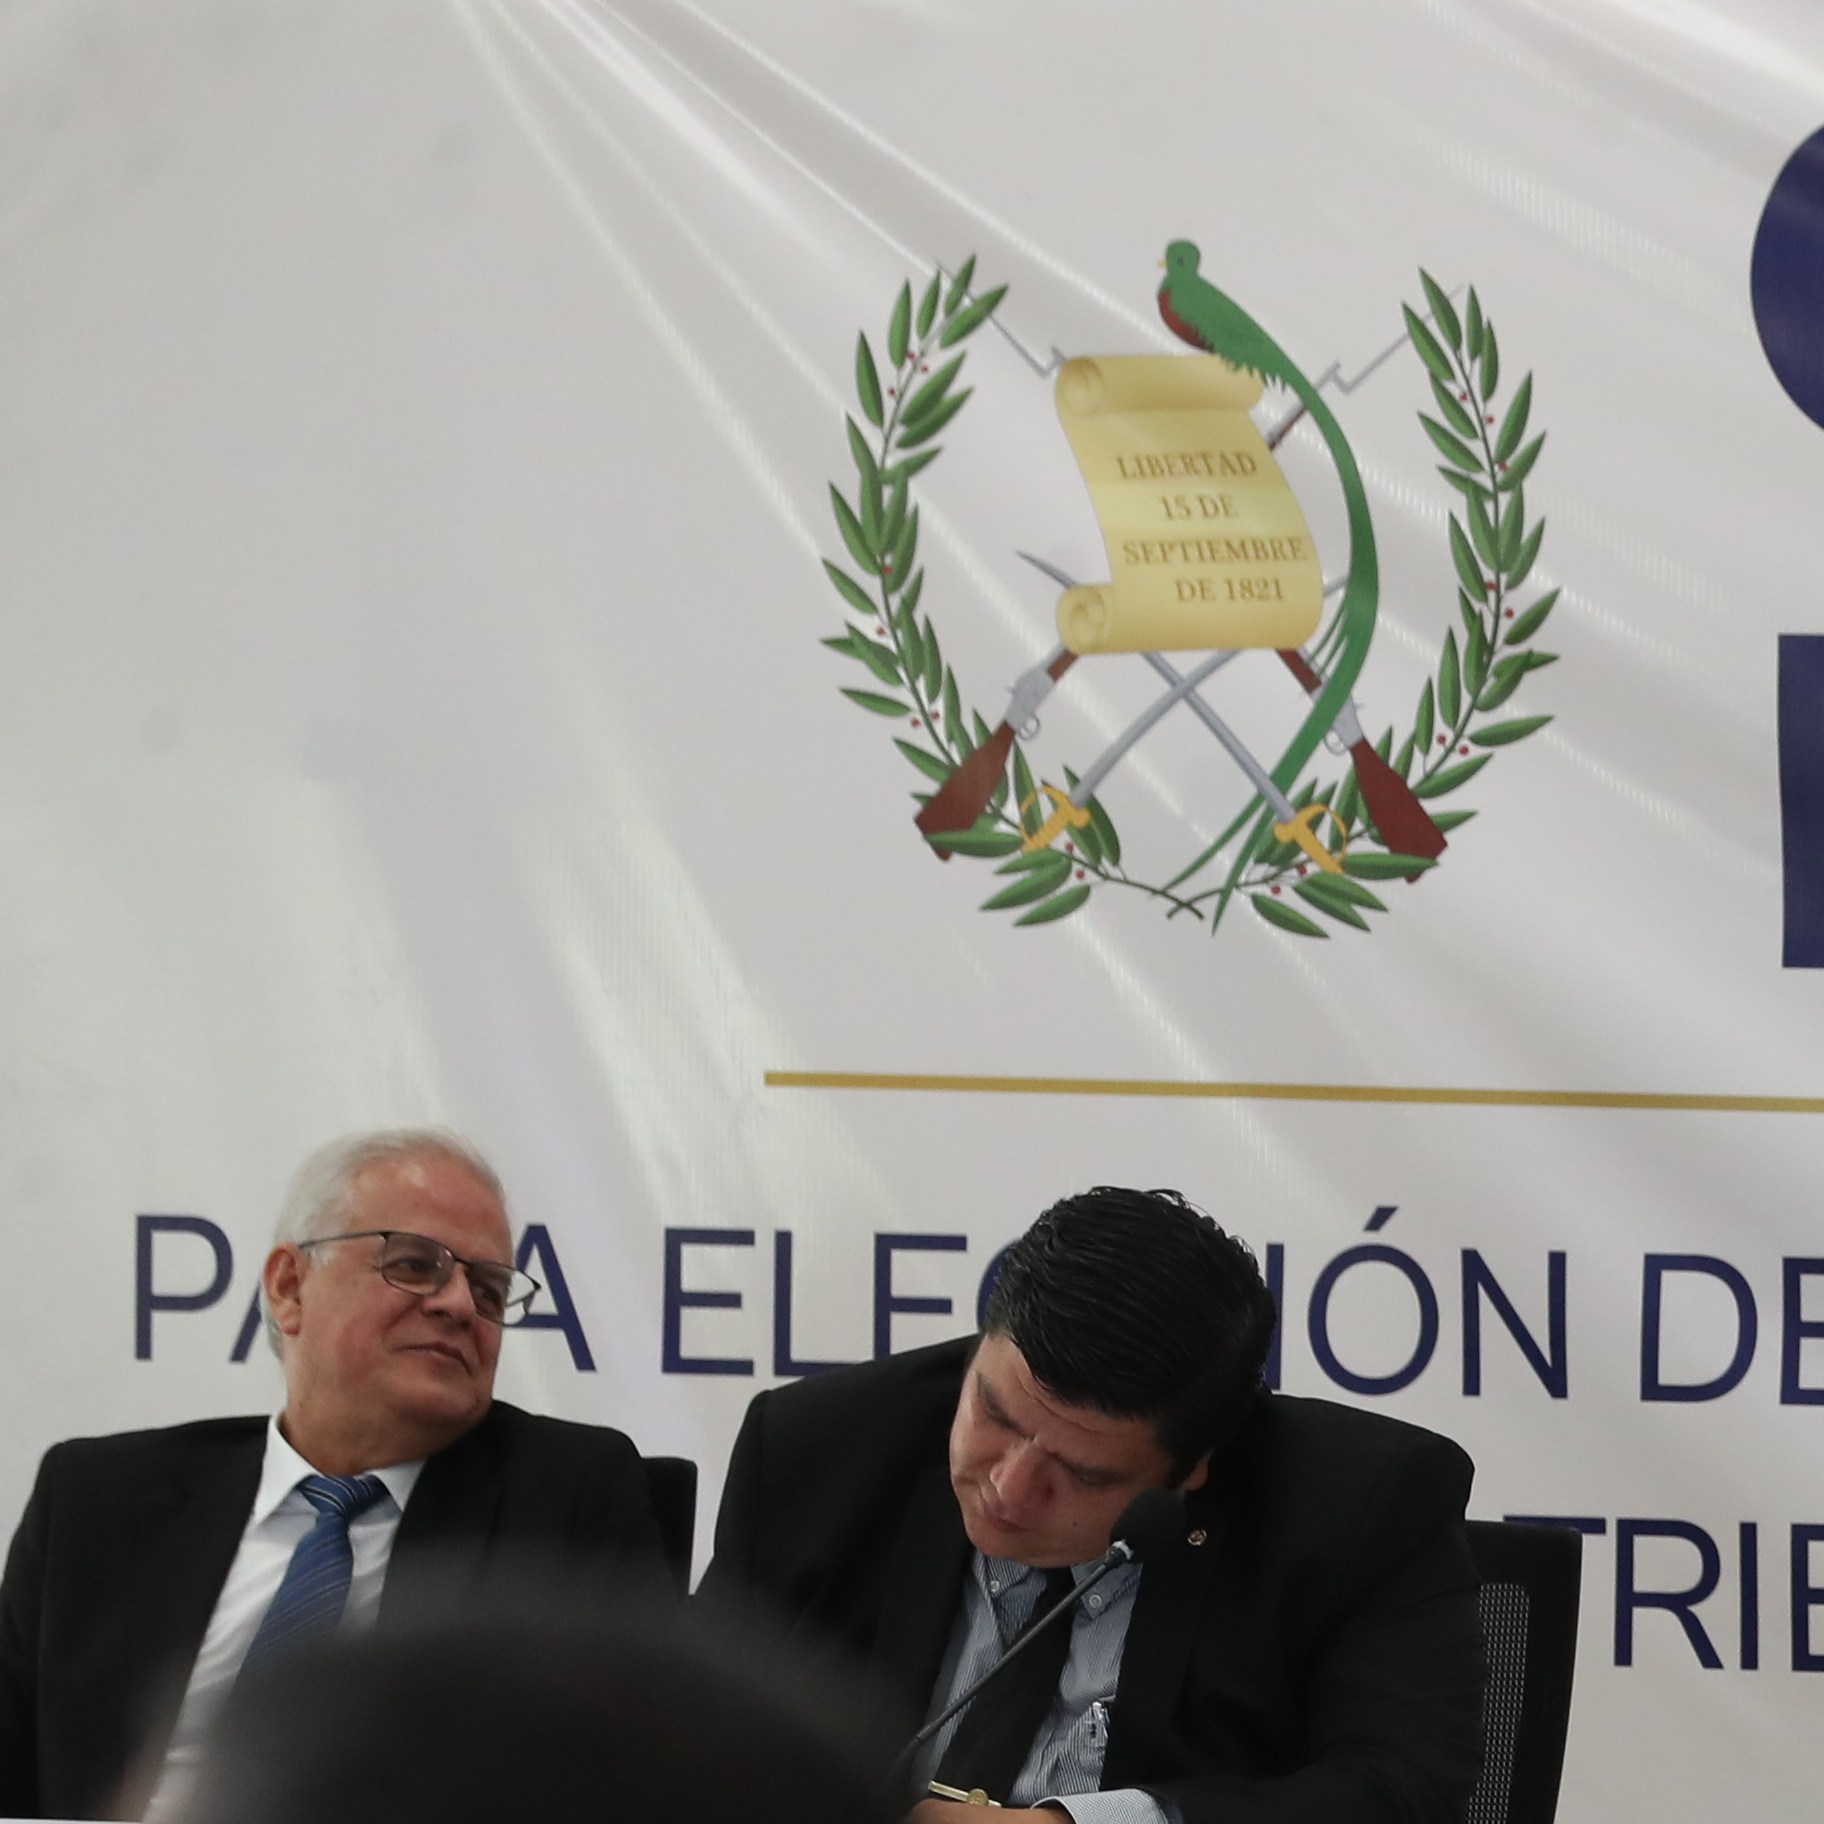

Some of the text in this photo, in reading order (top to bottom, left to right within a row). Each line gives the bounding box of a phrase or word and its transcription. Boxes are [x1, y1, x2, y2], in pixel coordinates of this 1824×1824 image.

[1116, 451, 1258, 481] LIBERTAD
[1159, 494, 1239, 522] 15 DE
[1121, 535, 1308, 566] SEPTIEMBRE
[1175, 577, 1285, 603] DE 1821
[134, 1214, 597, 1373] PA
[660, 1205, 1568, 1397] ELEIÓN
